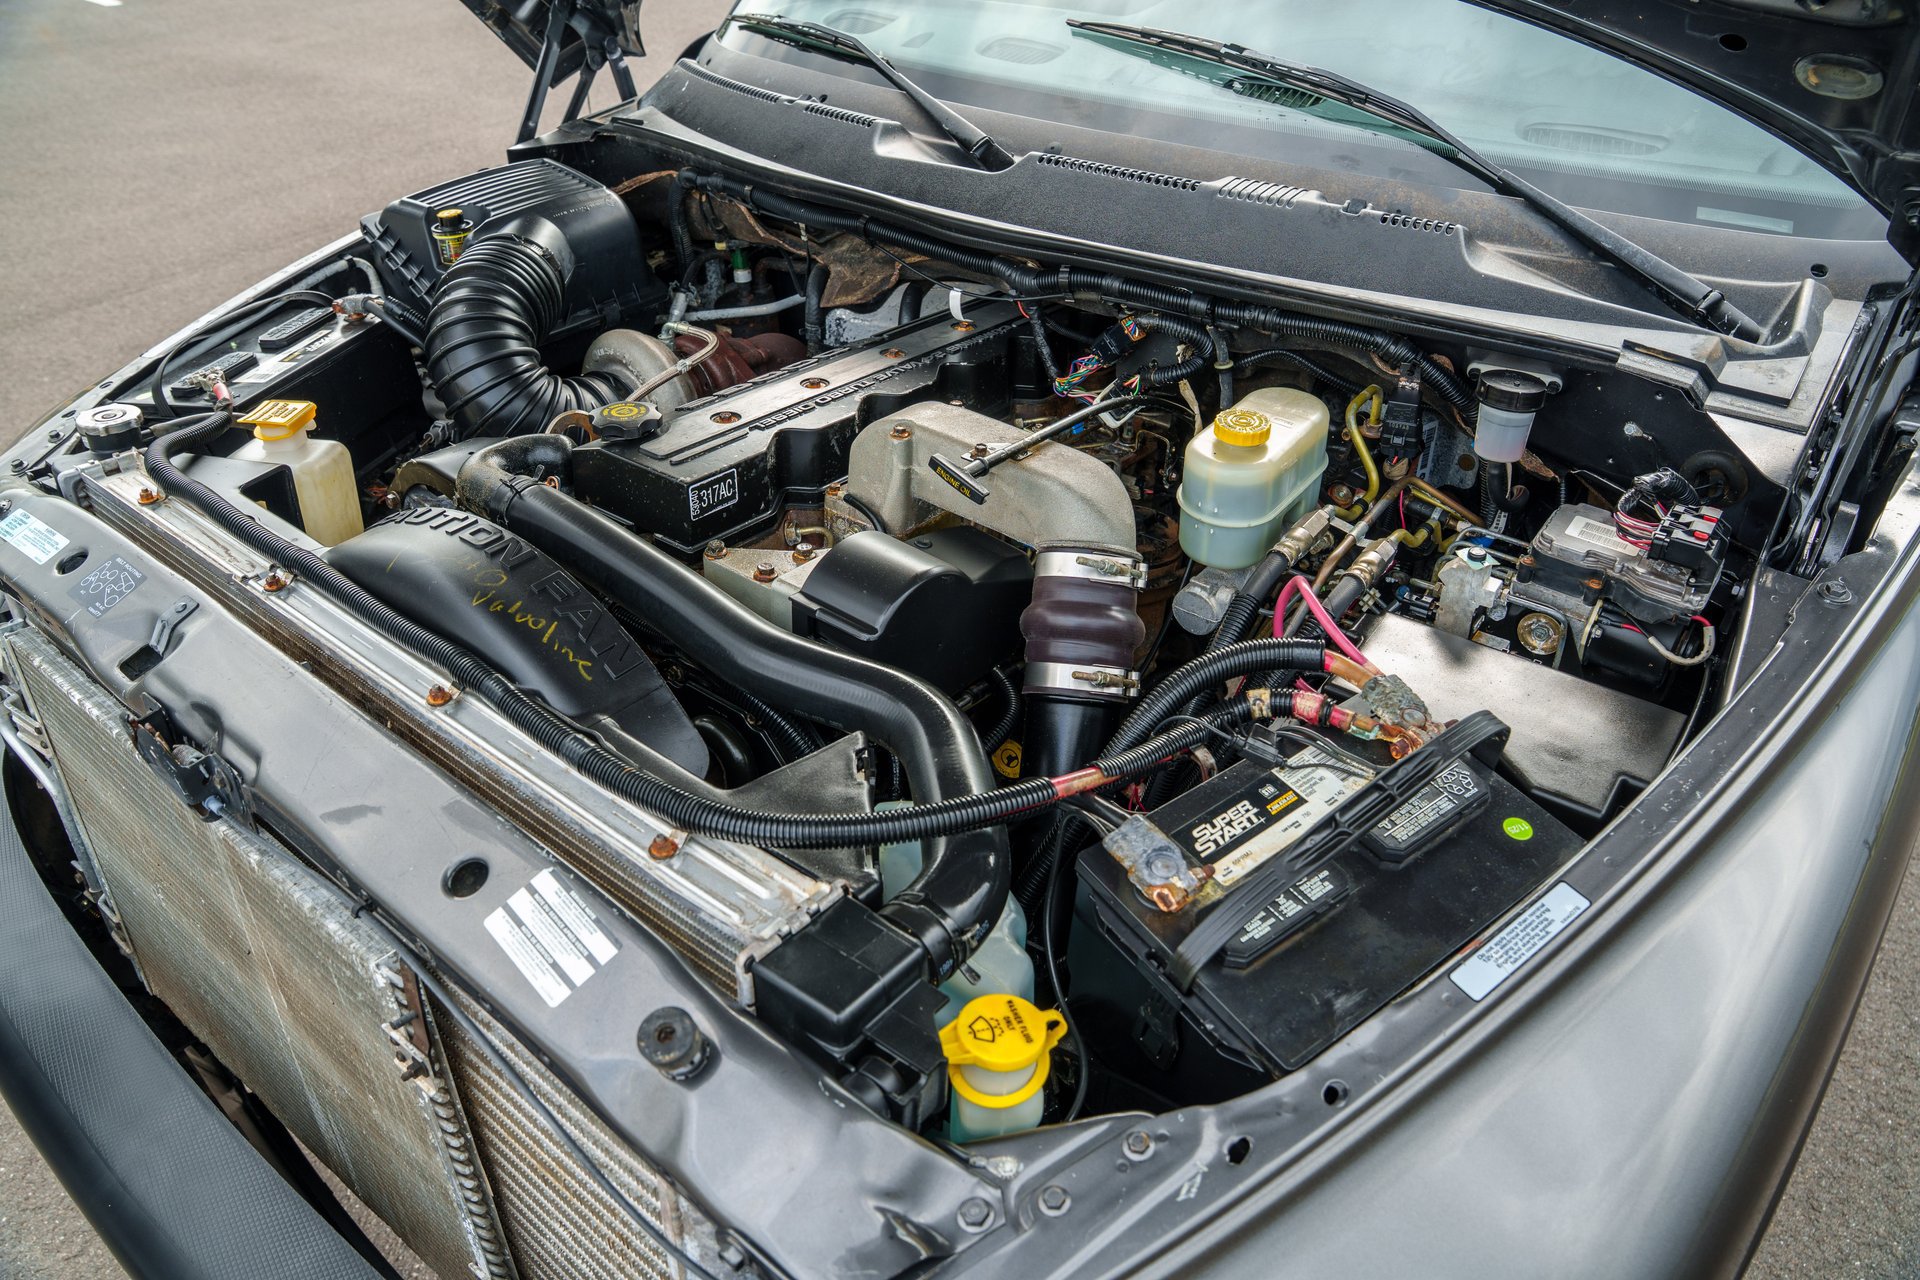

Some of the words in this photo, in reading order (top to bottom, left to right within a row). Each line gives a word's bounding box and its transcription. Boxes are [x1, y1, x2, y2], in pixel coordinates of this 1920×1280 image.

[817, 377, 876, 406] TURBO
[749, 401, 816, 434] DIESEL
[698, 478, 735, 507] 317AC
[935, 466, 960, 489] ENGINE
[959, 485, 972, 498] OIL
[124, 563, 142, 579] ROUTING
[366, 507, 538, 568] AUTION
[531, 570, 646, 680] FAN
[1190, 798, 1254, 843] SUPER
[1194, 806, 1266, 859] START
[569, 889, 588, 910] SERVICE
[583, 906, 597, 921] NOTE
[1505, 925, 1518, 938] more
[1517, 916, 1529, 928] than
[1528, 902, 1546, 919] nominal
[1535, 907, 1551, 923] during
[1002, 1015, 1016, 1032] ONLY
[1006, 999, 1024, 1025] WASHER
[1019, 1024, 1034, 1045] FLUID
